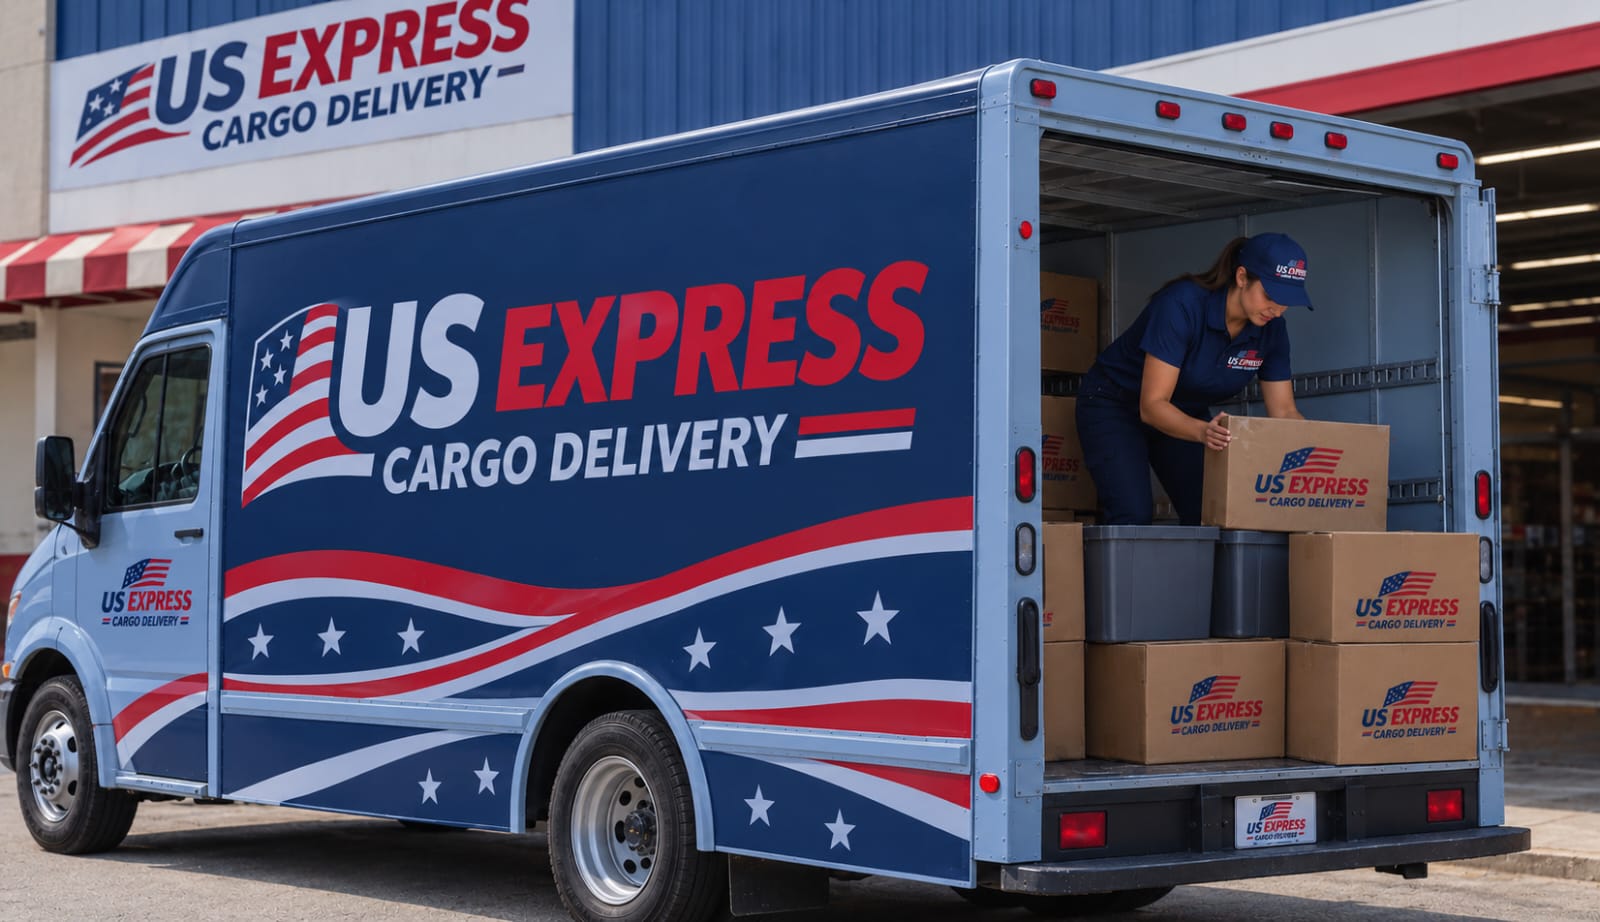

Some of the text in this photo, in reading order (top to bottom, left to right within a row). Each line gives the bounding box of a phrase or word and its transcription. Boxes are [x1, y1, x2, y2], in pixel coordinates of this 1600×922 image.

[154, 0, 531, 126] US EXPRESS
[202, 65, 491, 151] CARGO DELIVERY
[1275, 264, 1288, 274] US
[338, 260, 930, 438] US EXPRESS
[1227, 356, 1239, 366] US
[382, 414, 789, 495] CARGO DELIVERY
[1042, 457, 1080, 473] PRESS
[1255, 474, 1369, 496] US EXPRESS
[1269, 497, 1353, 508] CARGO DELIVERY
[101, 590, 192, 613] US EXPRESS
[1356, 598, 1459, 617] US EXPRESS
[112, 615, 179, 627] CARGO DELIVERY
[1368, 619, 1445, 629] CARGO DELIVERY
[1171, 700, 1263, 724] US EXPRESS
[1362, 706, 1460, 727] US EXPRESS
[1181, 720, 1250, 735] CARGO DELIVERY
[1373, 726, 1446, 739] CARGO DELIVERY
[1247, 819, 1306, 835] US EXPRESS
